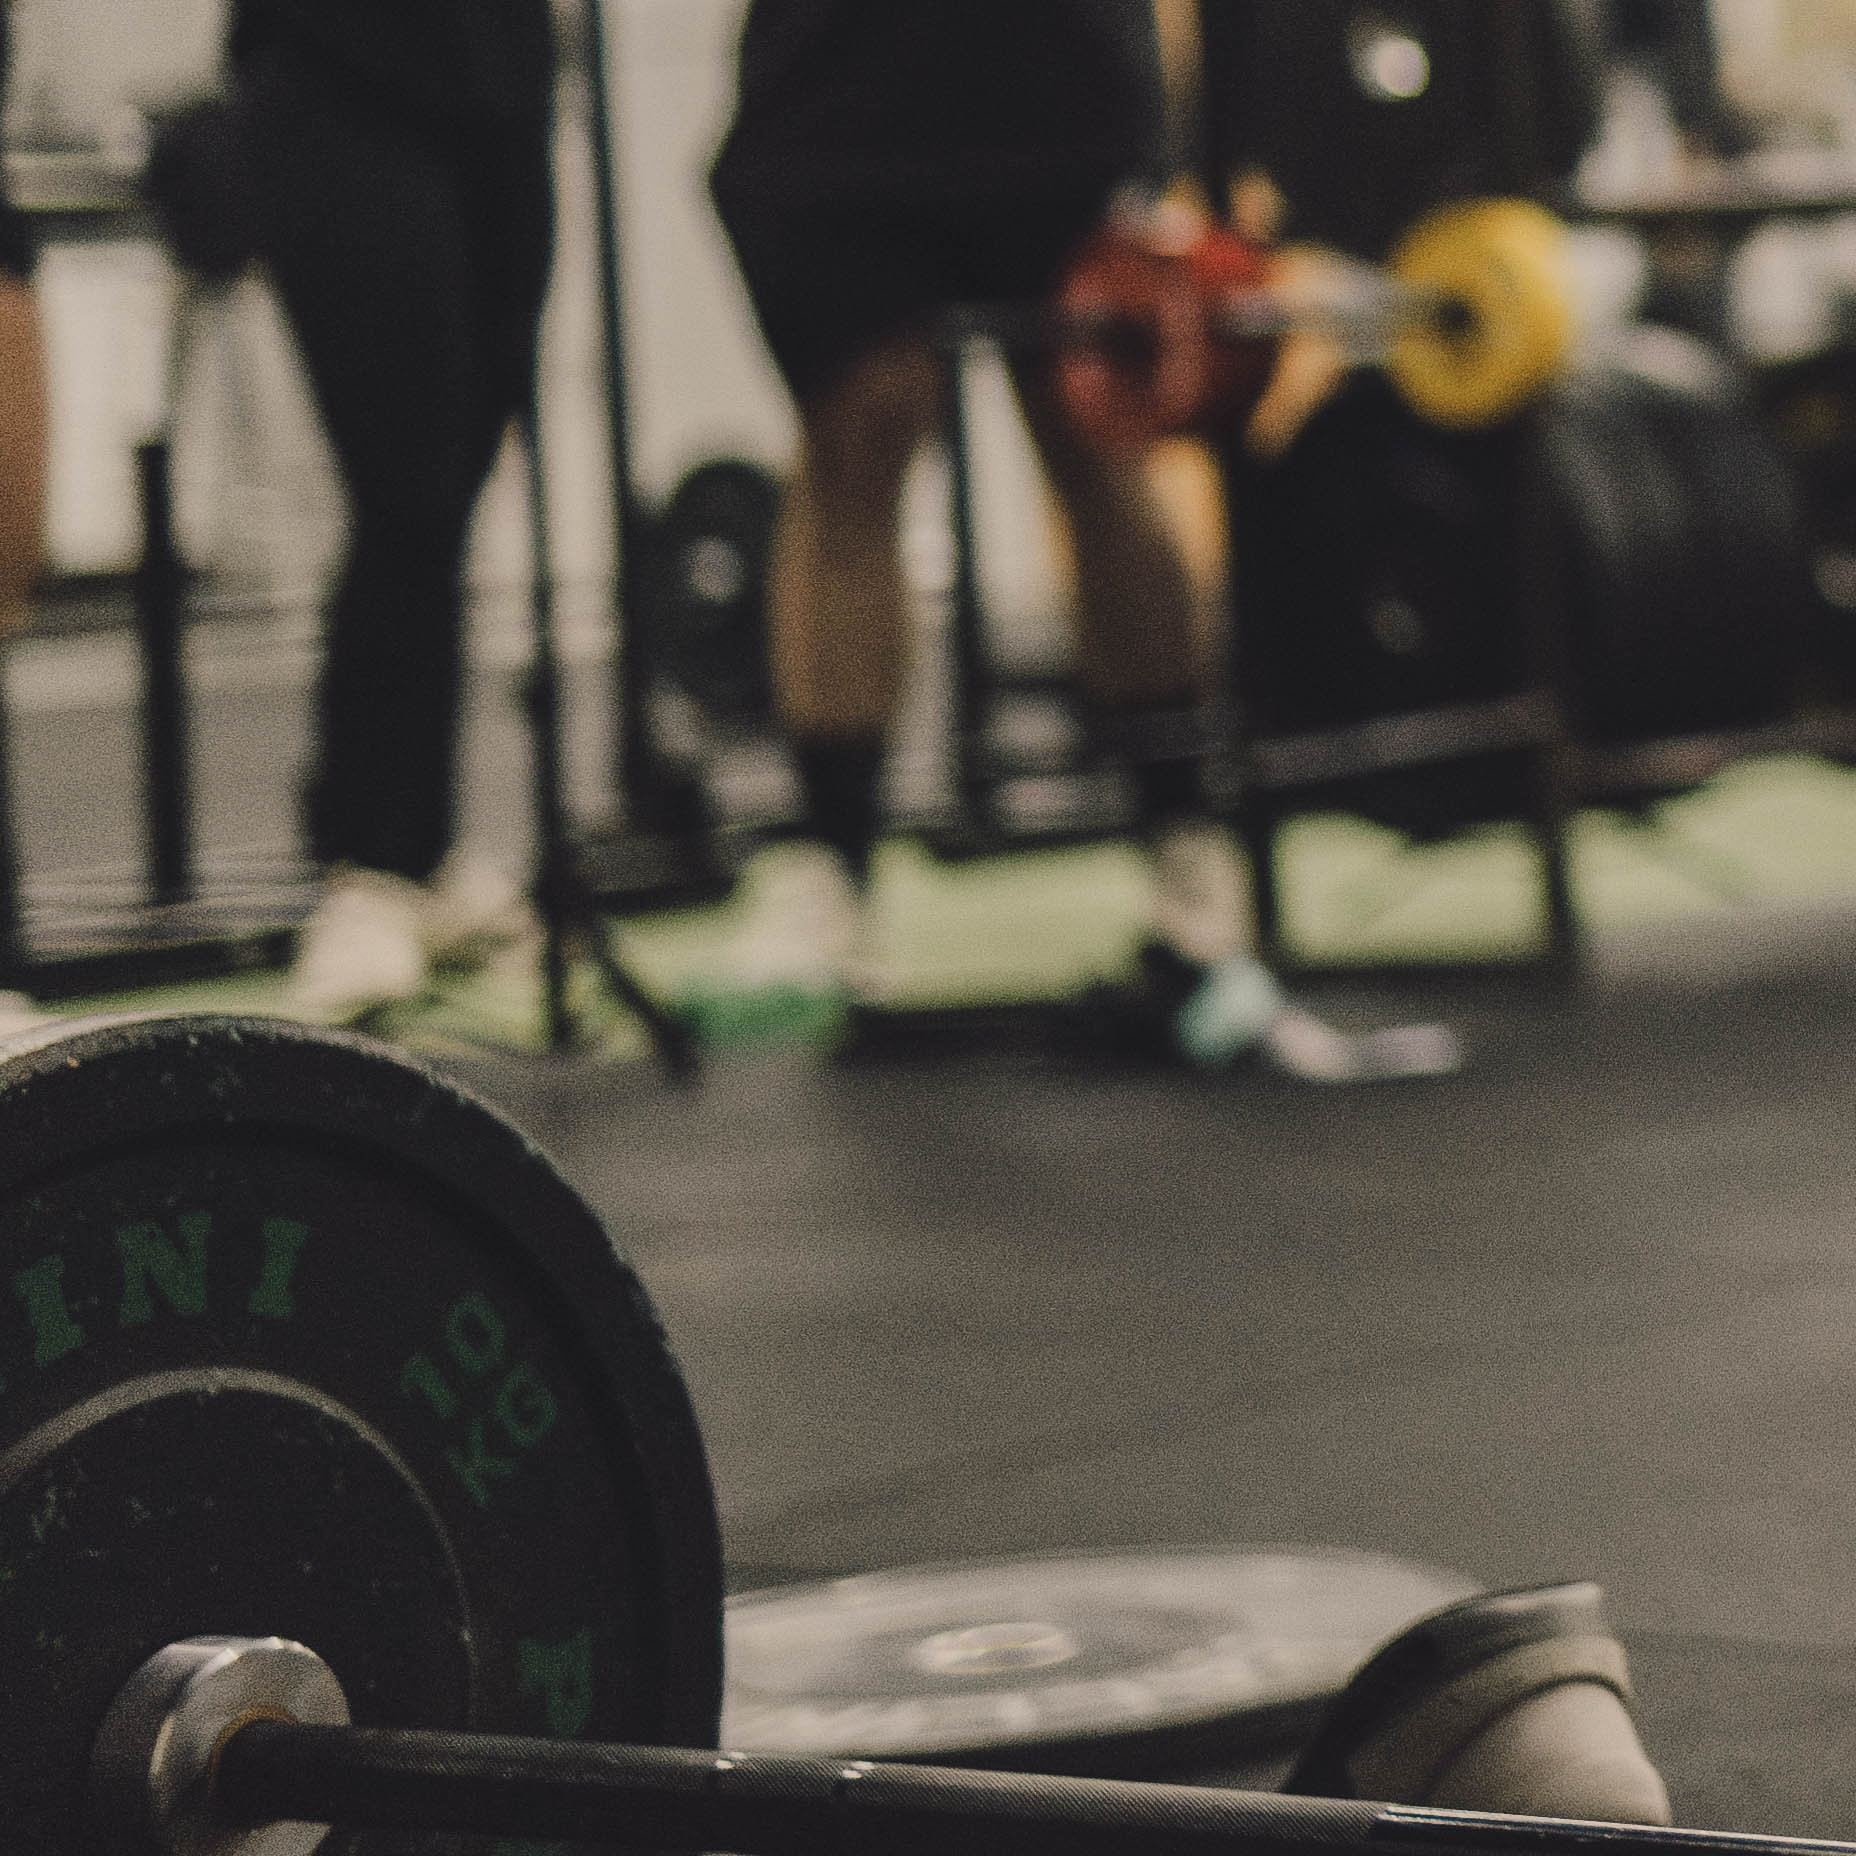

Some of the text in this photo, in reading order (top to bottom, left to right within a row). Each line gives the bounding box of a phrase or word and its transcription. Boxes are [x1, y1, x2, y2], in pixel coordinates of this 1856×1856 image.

[14, 1212, 310, 1369] INI
[398, 1290, 510, 1422] 10
[443, 1359, 562, 1510] KG
